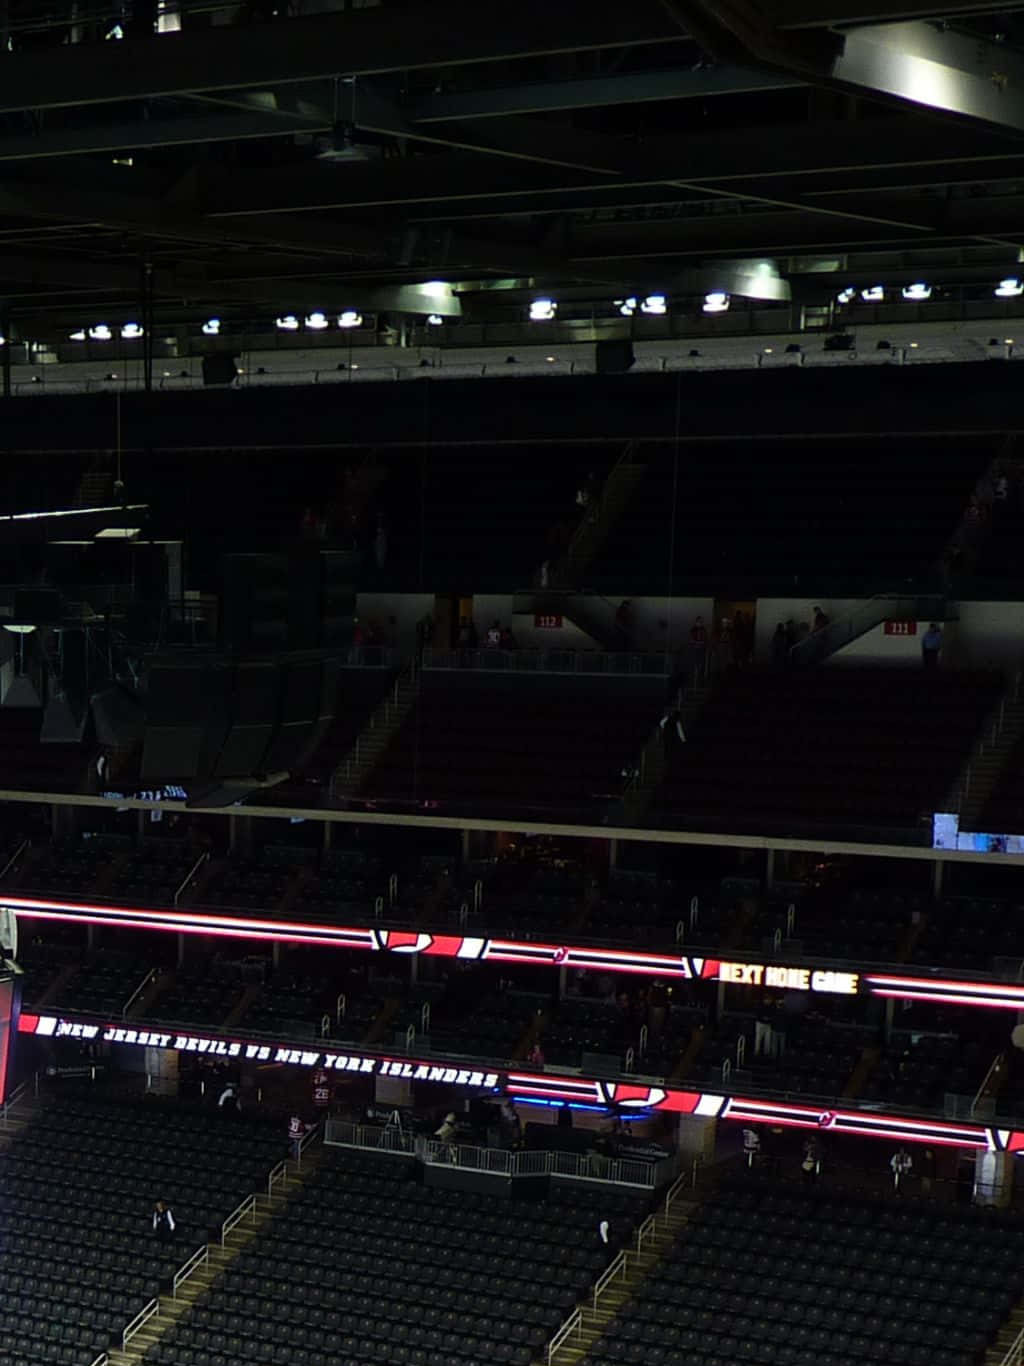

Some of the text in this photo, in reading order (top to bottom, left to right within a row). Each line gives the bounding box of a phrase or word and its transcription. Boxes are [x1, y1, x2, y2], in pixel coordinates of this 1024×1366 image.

[59, 1021, 499, 1088] NEW JERSEY DEVILS VS NEW YORK ISLANDERS
